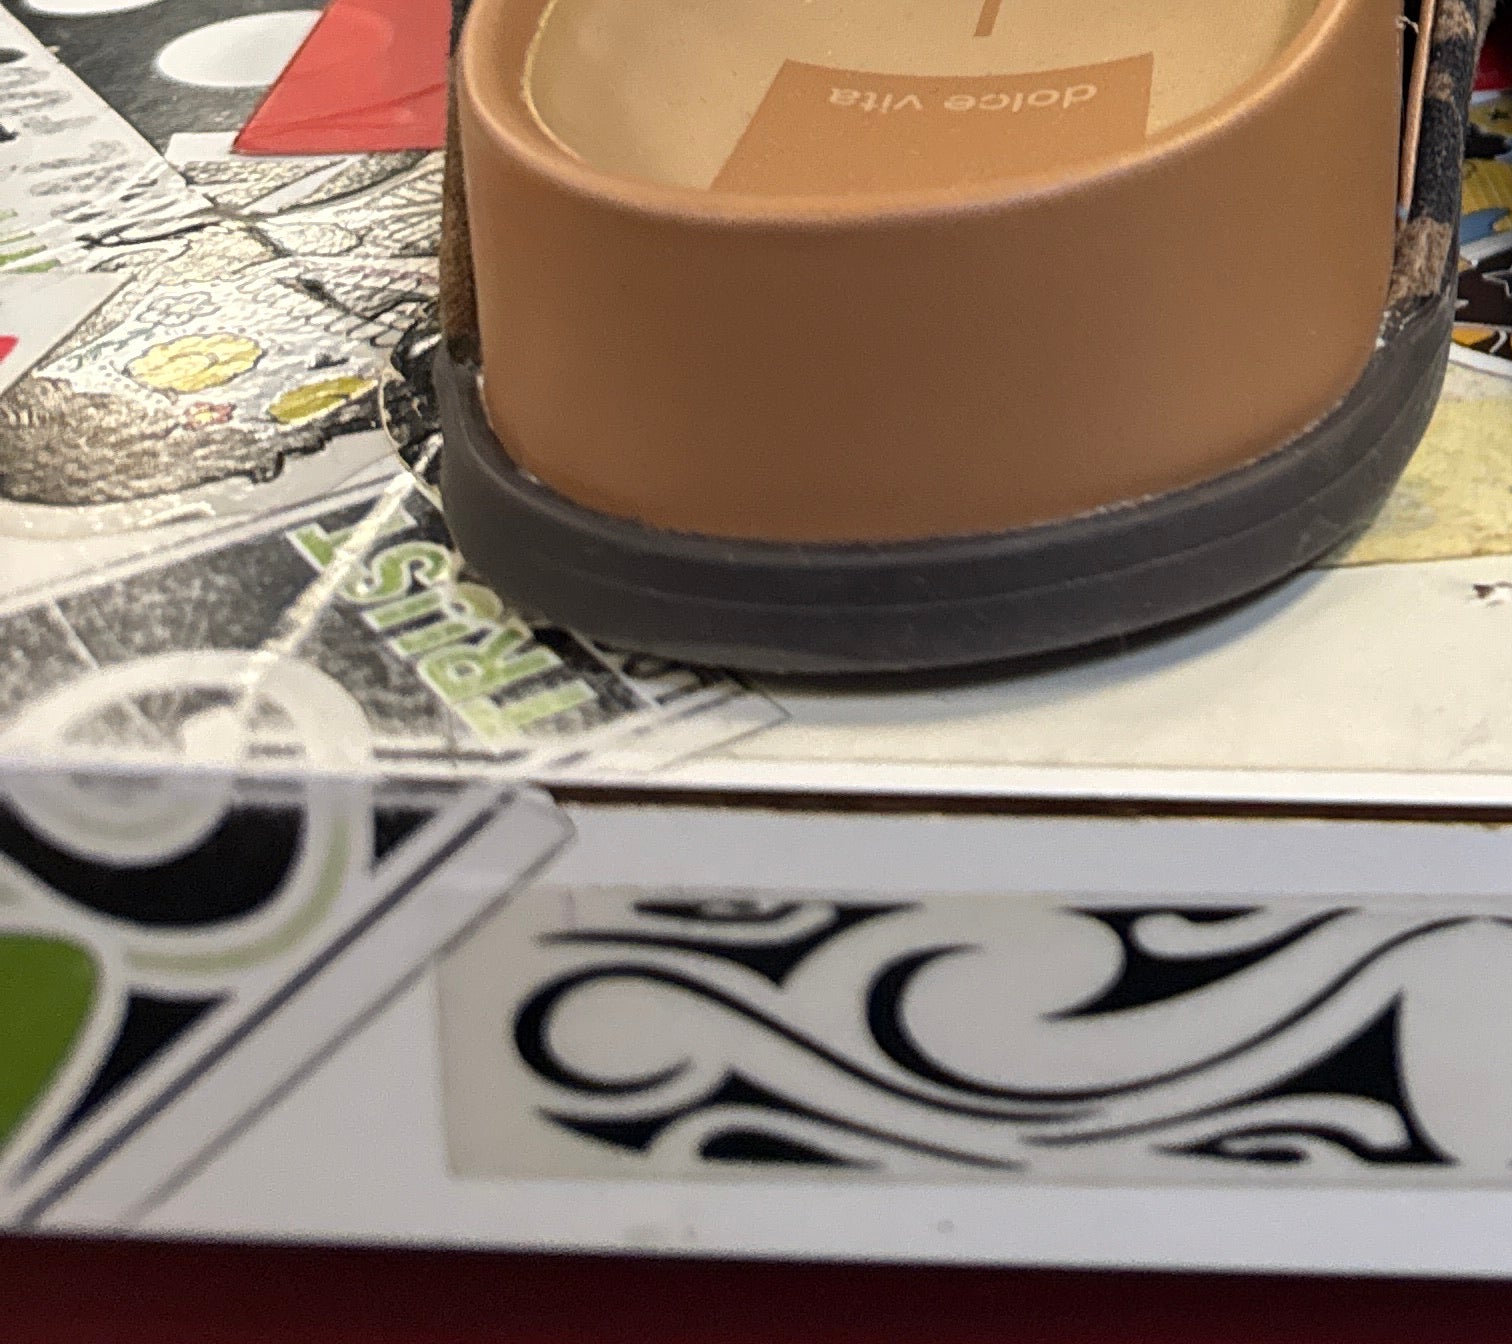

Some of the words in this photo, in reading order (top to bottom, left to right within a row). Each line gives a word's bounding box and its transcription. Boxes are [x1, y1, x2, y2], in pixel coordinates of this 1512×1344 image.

[828, 87, 924, 113] vita
[944, 82, 1098, 113] dolce
[285, 511, 598, 752] TRUST
